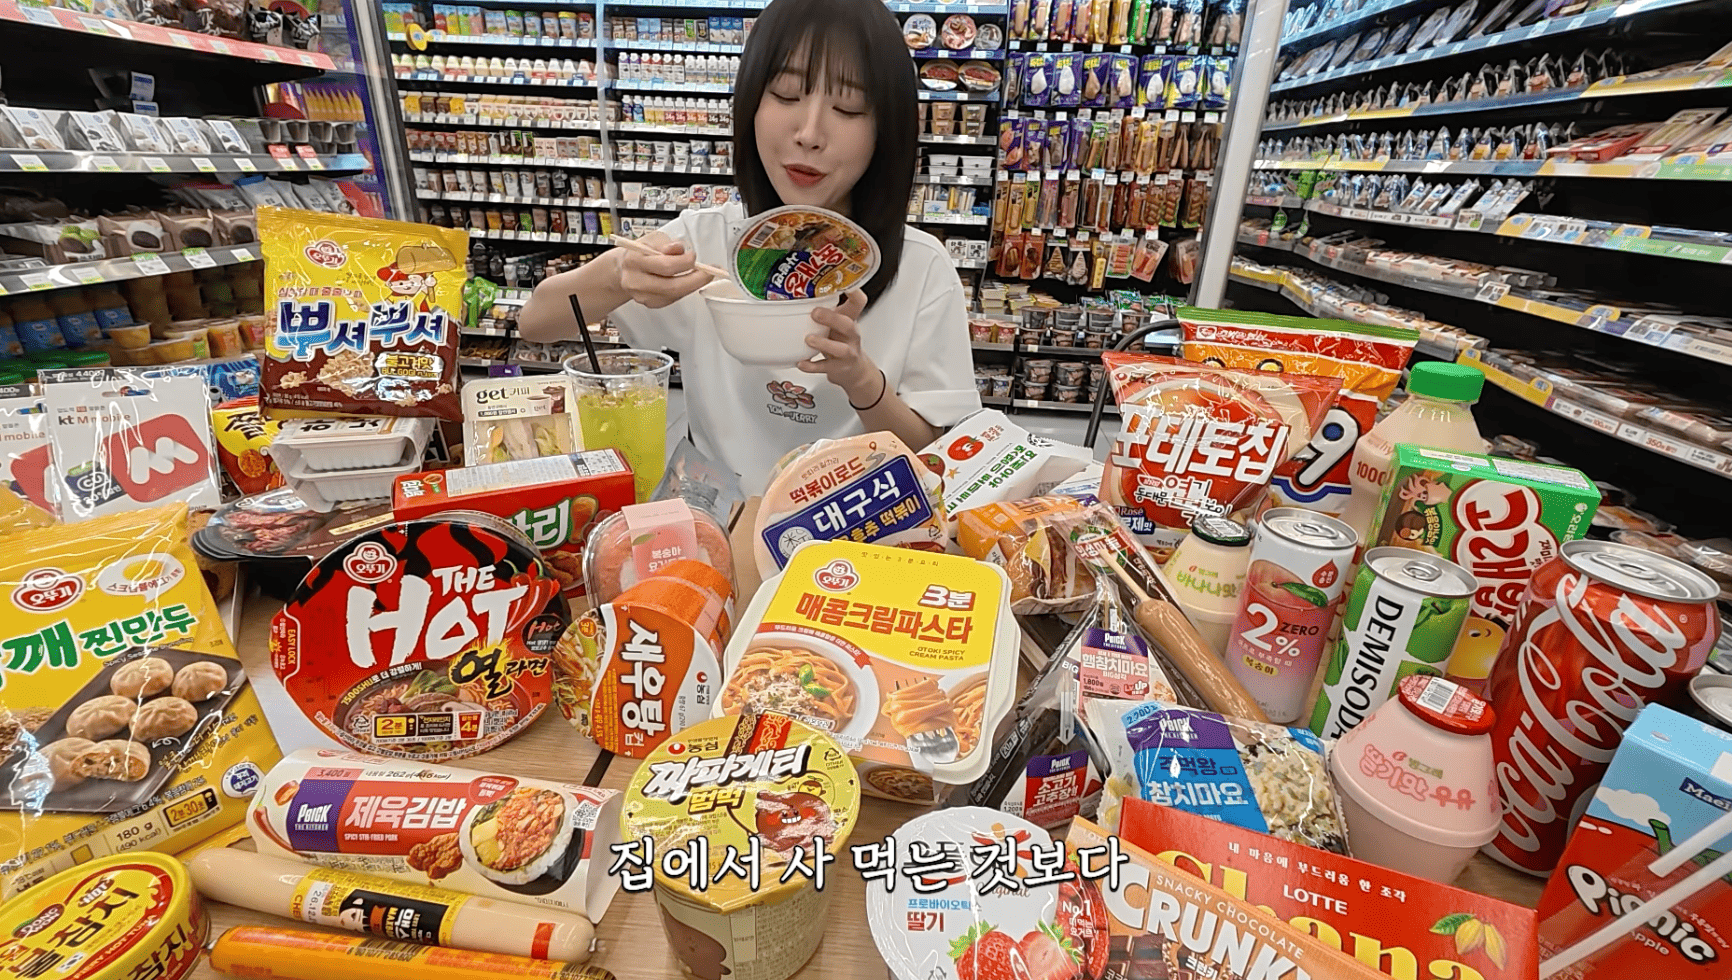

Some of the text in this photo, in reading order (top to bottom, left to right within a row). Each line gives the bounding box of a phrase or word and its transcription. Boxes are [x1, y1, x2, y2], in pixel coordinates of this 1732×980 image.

[772, 252, 799, 288] 사발면
[784, 244, 846, 297] 육개장
[276, 301, 446, 357] 뿌셔뿌셔
[476, 387, 509, 404] get
[58, 414, 74, 426] kt
[77, 413, 90, 424] M
[767, 404, 818, 424] TOM JERRY
[1112, 402, 1289, 484] 포테토칩
[789, 458, 865, 503] 떡볶이로드
[813, 472, 901, 533] 대구식
[1135, 486, 1168, 505] 동대문
[879, 498, 921, 527] 떡볶이
[1120, 507, 1145, 516] Rosé
[652, 546, 681, 557] 복숭아
[1464, 489, 1536, 624] 고래밥
[355, 563, 386, 575] 오뚜기
[433, 565, 496, 596] THE
[821, 575, 850, 587] 오뚜기
[30, 585, 73, 606] 오뚜기
[919, 585, 975, 611] 3분
[346, 574, 529, 668] HOT
[795, 592, 973, 643] 매콤크림파스타
[79, 604, 197, 657] 찐만두
[1240, 603, 1319, 658] 2% ZERO
[103, 654, 129, 667] Spicy
[909, 651, 964, 661] CREAM PASTA
[917, 646, 965, 657] OTOKI SPICY
[452, 648, 547, 699] 열라면
[621, 620, 666, 735] 새우탕
[1061, 660, 1079, 674] BIG
[1082, 653, 1149, 679] 햄참치마요
[1245, 655, 1274, 675] 복숭아
[625, 732, 644, 746] 컵
[688, 740, 719, 752] 농심
[642, 745, 812, 803] 짜파게티
[1038, 774, 1076, 794] 소고기
[688, 788, 746, 814] 범벅
[1149, 782, 1249, 806] 참치마요
[1684, 782, 1732, 811] Maei
[297, 804, 332, 823] PBICK
[345, 796, 466, 829] 제육김밥
[116, 824, 139, 842] 180
[1228, 841, 1408, 903] 내 마음에 부드러움 한 조각
[81, 881, 111, 904] HOT
[1282, 884, 1349, 916] LOTTE
[1062, 899, 1092, 917] No.1
[1156, 875, 1305, 960] SNACKY CHOCOLATE
[907, 912, 944, 932] 딸기
[1630, 931, 1670, 956] pple
[1185, 955, 1218, 980] 크런키
